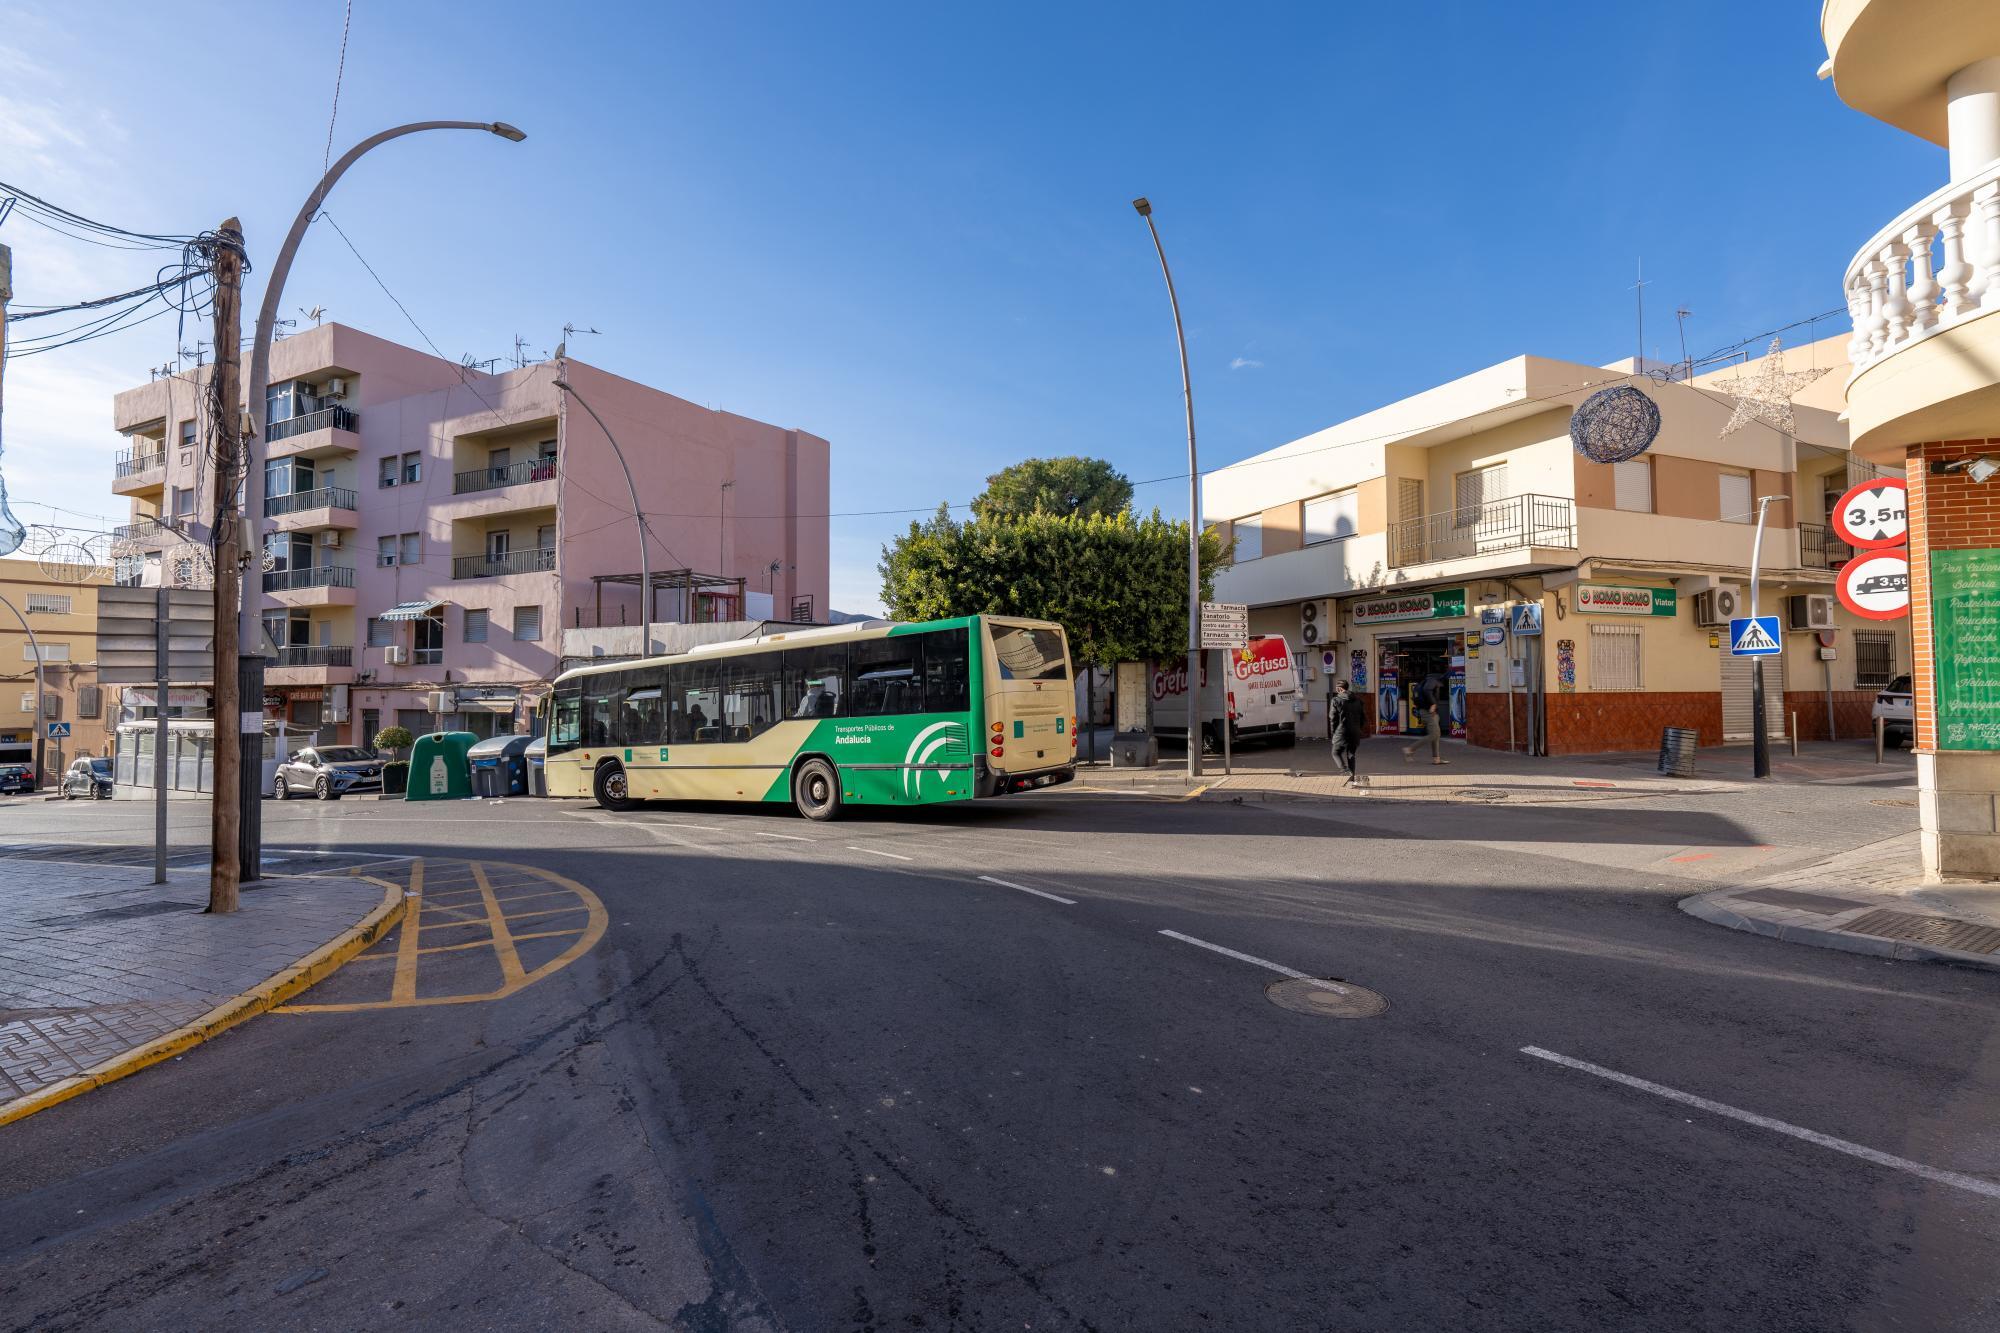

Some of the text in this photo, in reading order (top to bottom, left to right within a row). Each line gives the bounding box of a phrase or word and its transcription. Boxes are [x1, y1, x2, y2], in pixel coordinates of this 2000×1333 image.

[1942, 563, 1962, 573] Pan
[1592, 590, 1651, 607] KOMO KOMO
[1655, 597, 1675, 606] Viator
[1367, 598, 1431, 616] KOMO KOMO
[1436, 599, 1464, 608] Viator
[1236, 657, 1288, 679] Grefusa
[835, 725, 864, 733] Transportes
[835, 735, 872, 744] Andalucía
